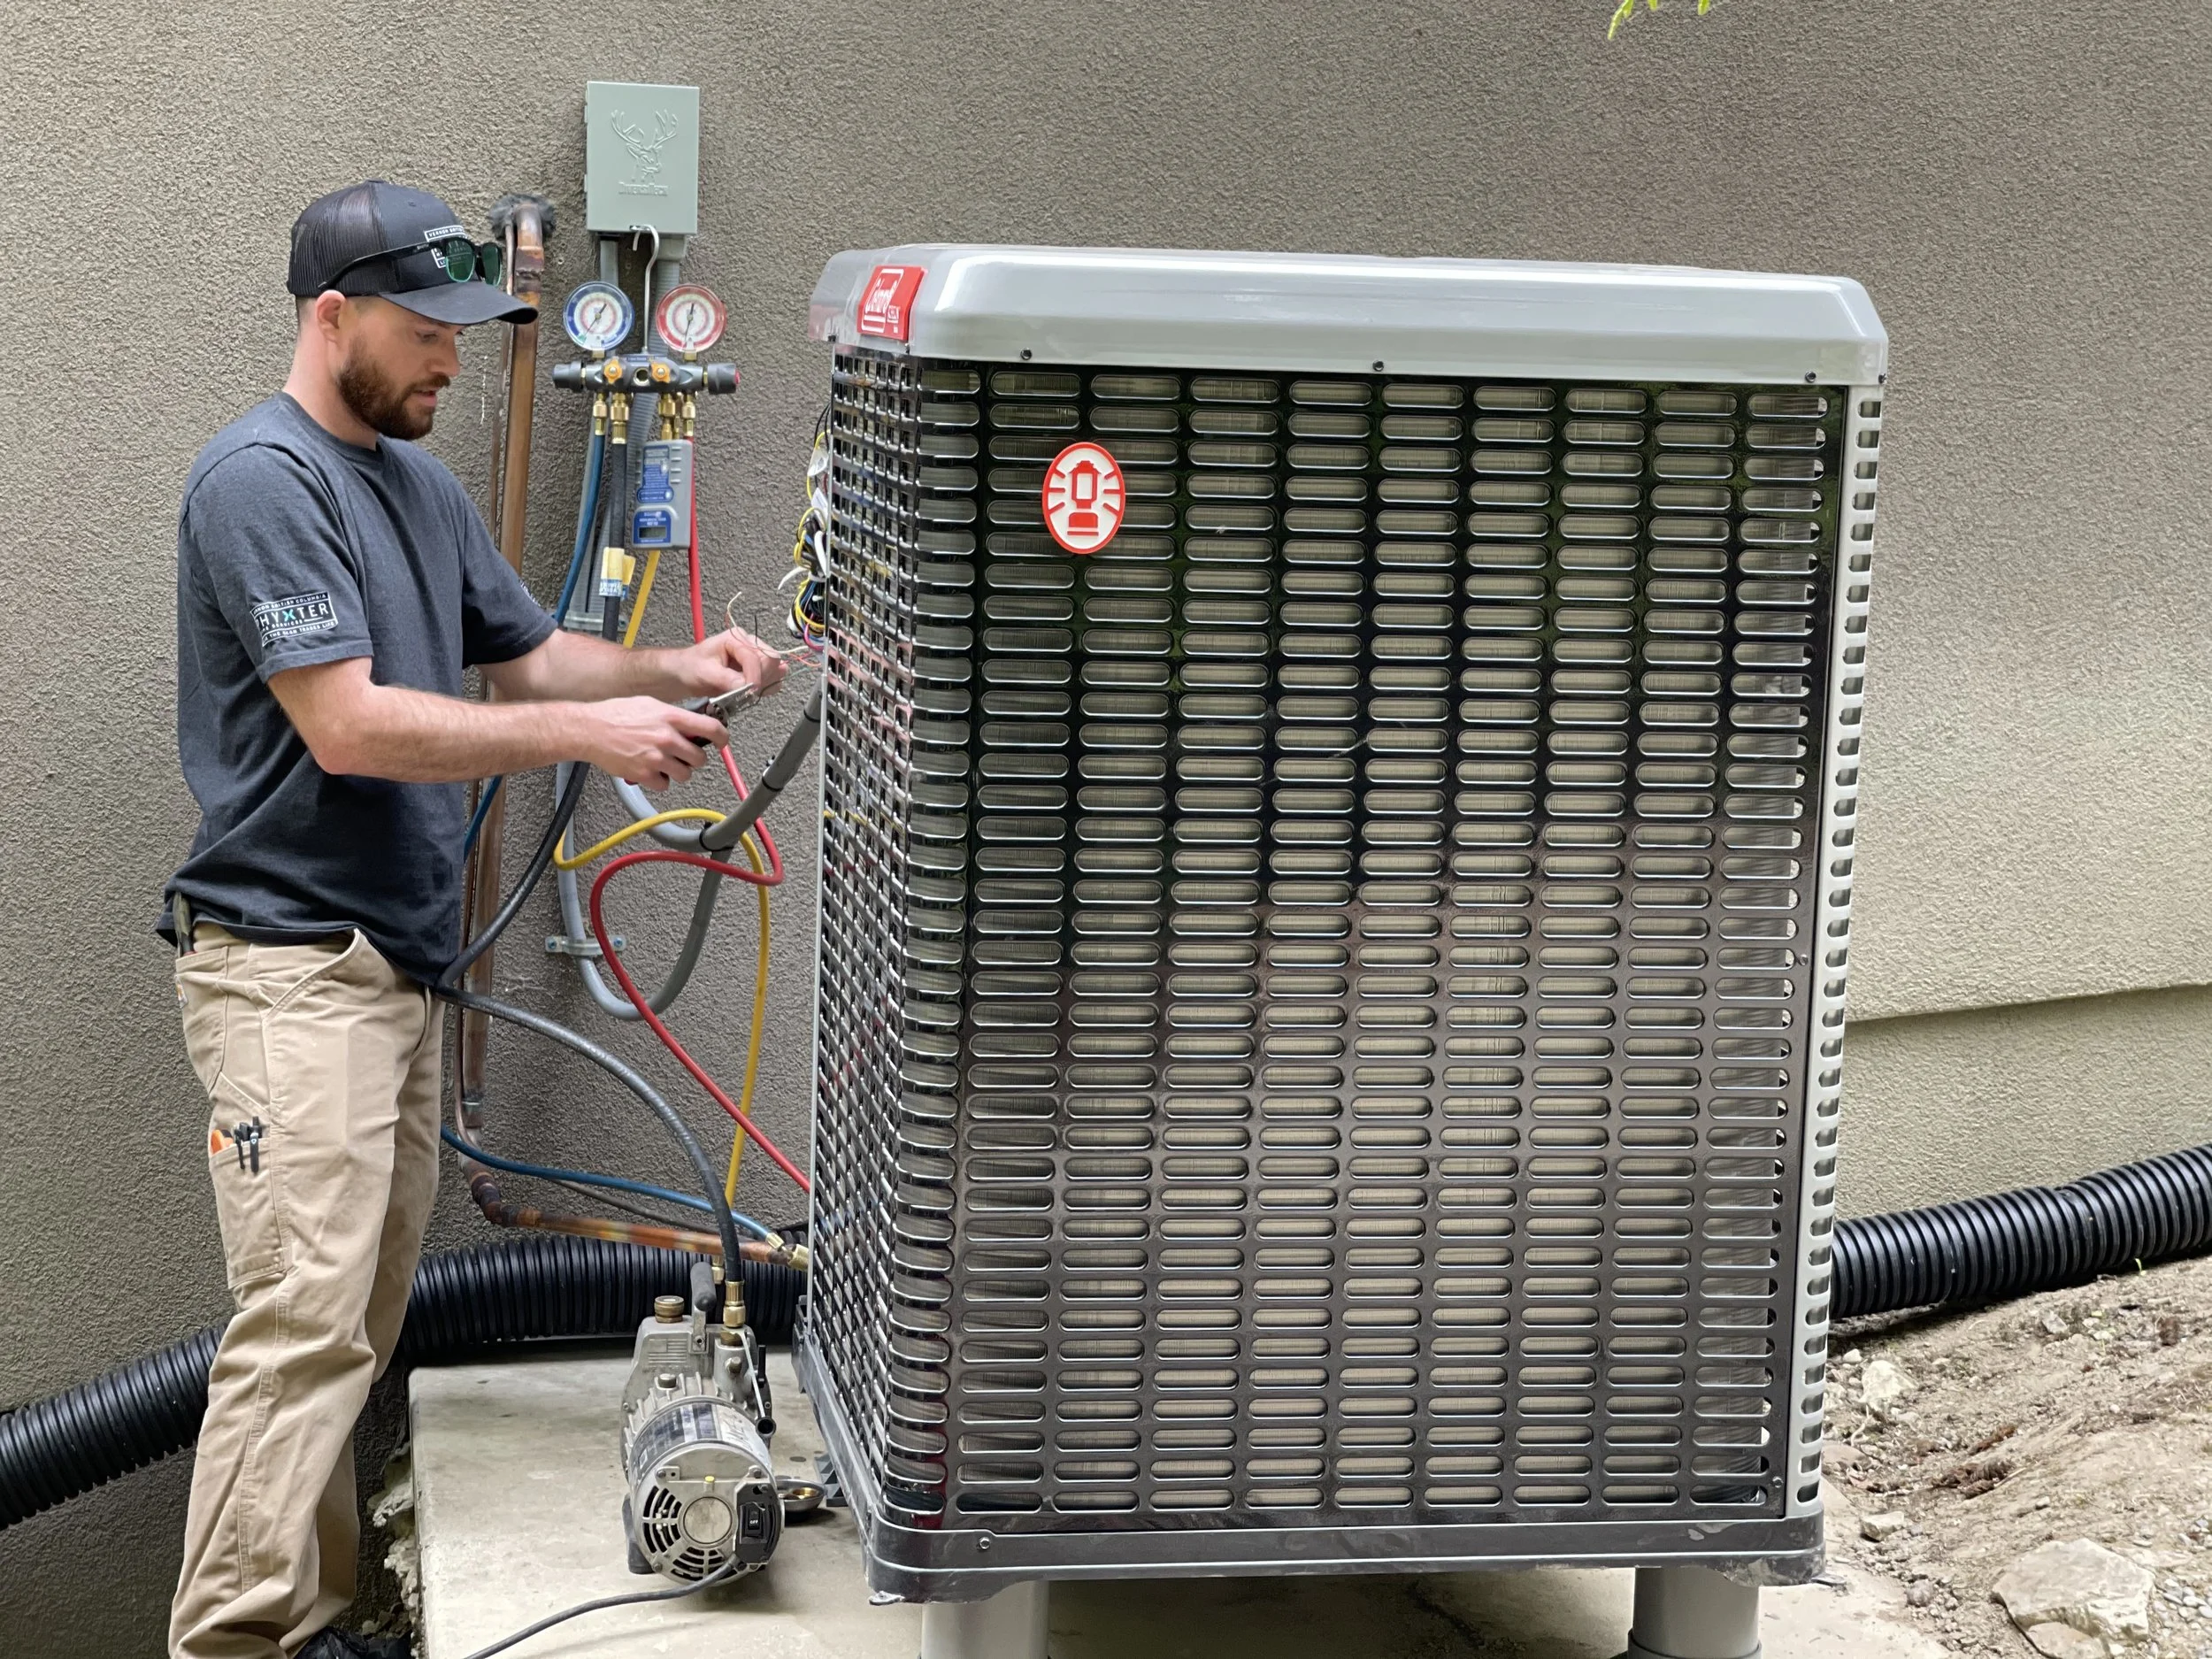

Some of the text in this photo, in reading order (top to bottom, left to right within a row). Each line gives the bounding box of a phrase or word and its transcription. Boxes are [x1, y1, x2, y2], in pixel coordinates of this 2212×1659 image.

[271, 600, 295, 609] BRITISH
[296, 594, 326, 604] COLUMBIA
[259, 603, 329, 627] HYXTER
[272, 618, 303, 629] SERVICES
[299, 624, 321, 633] TRADES
